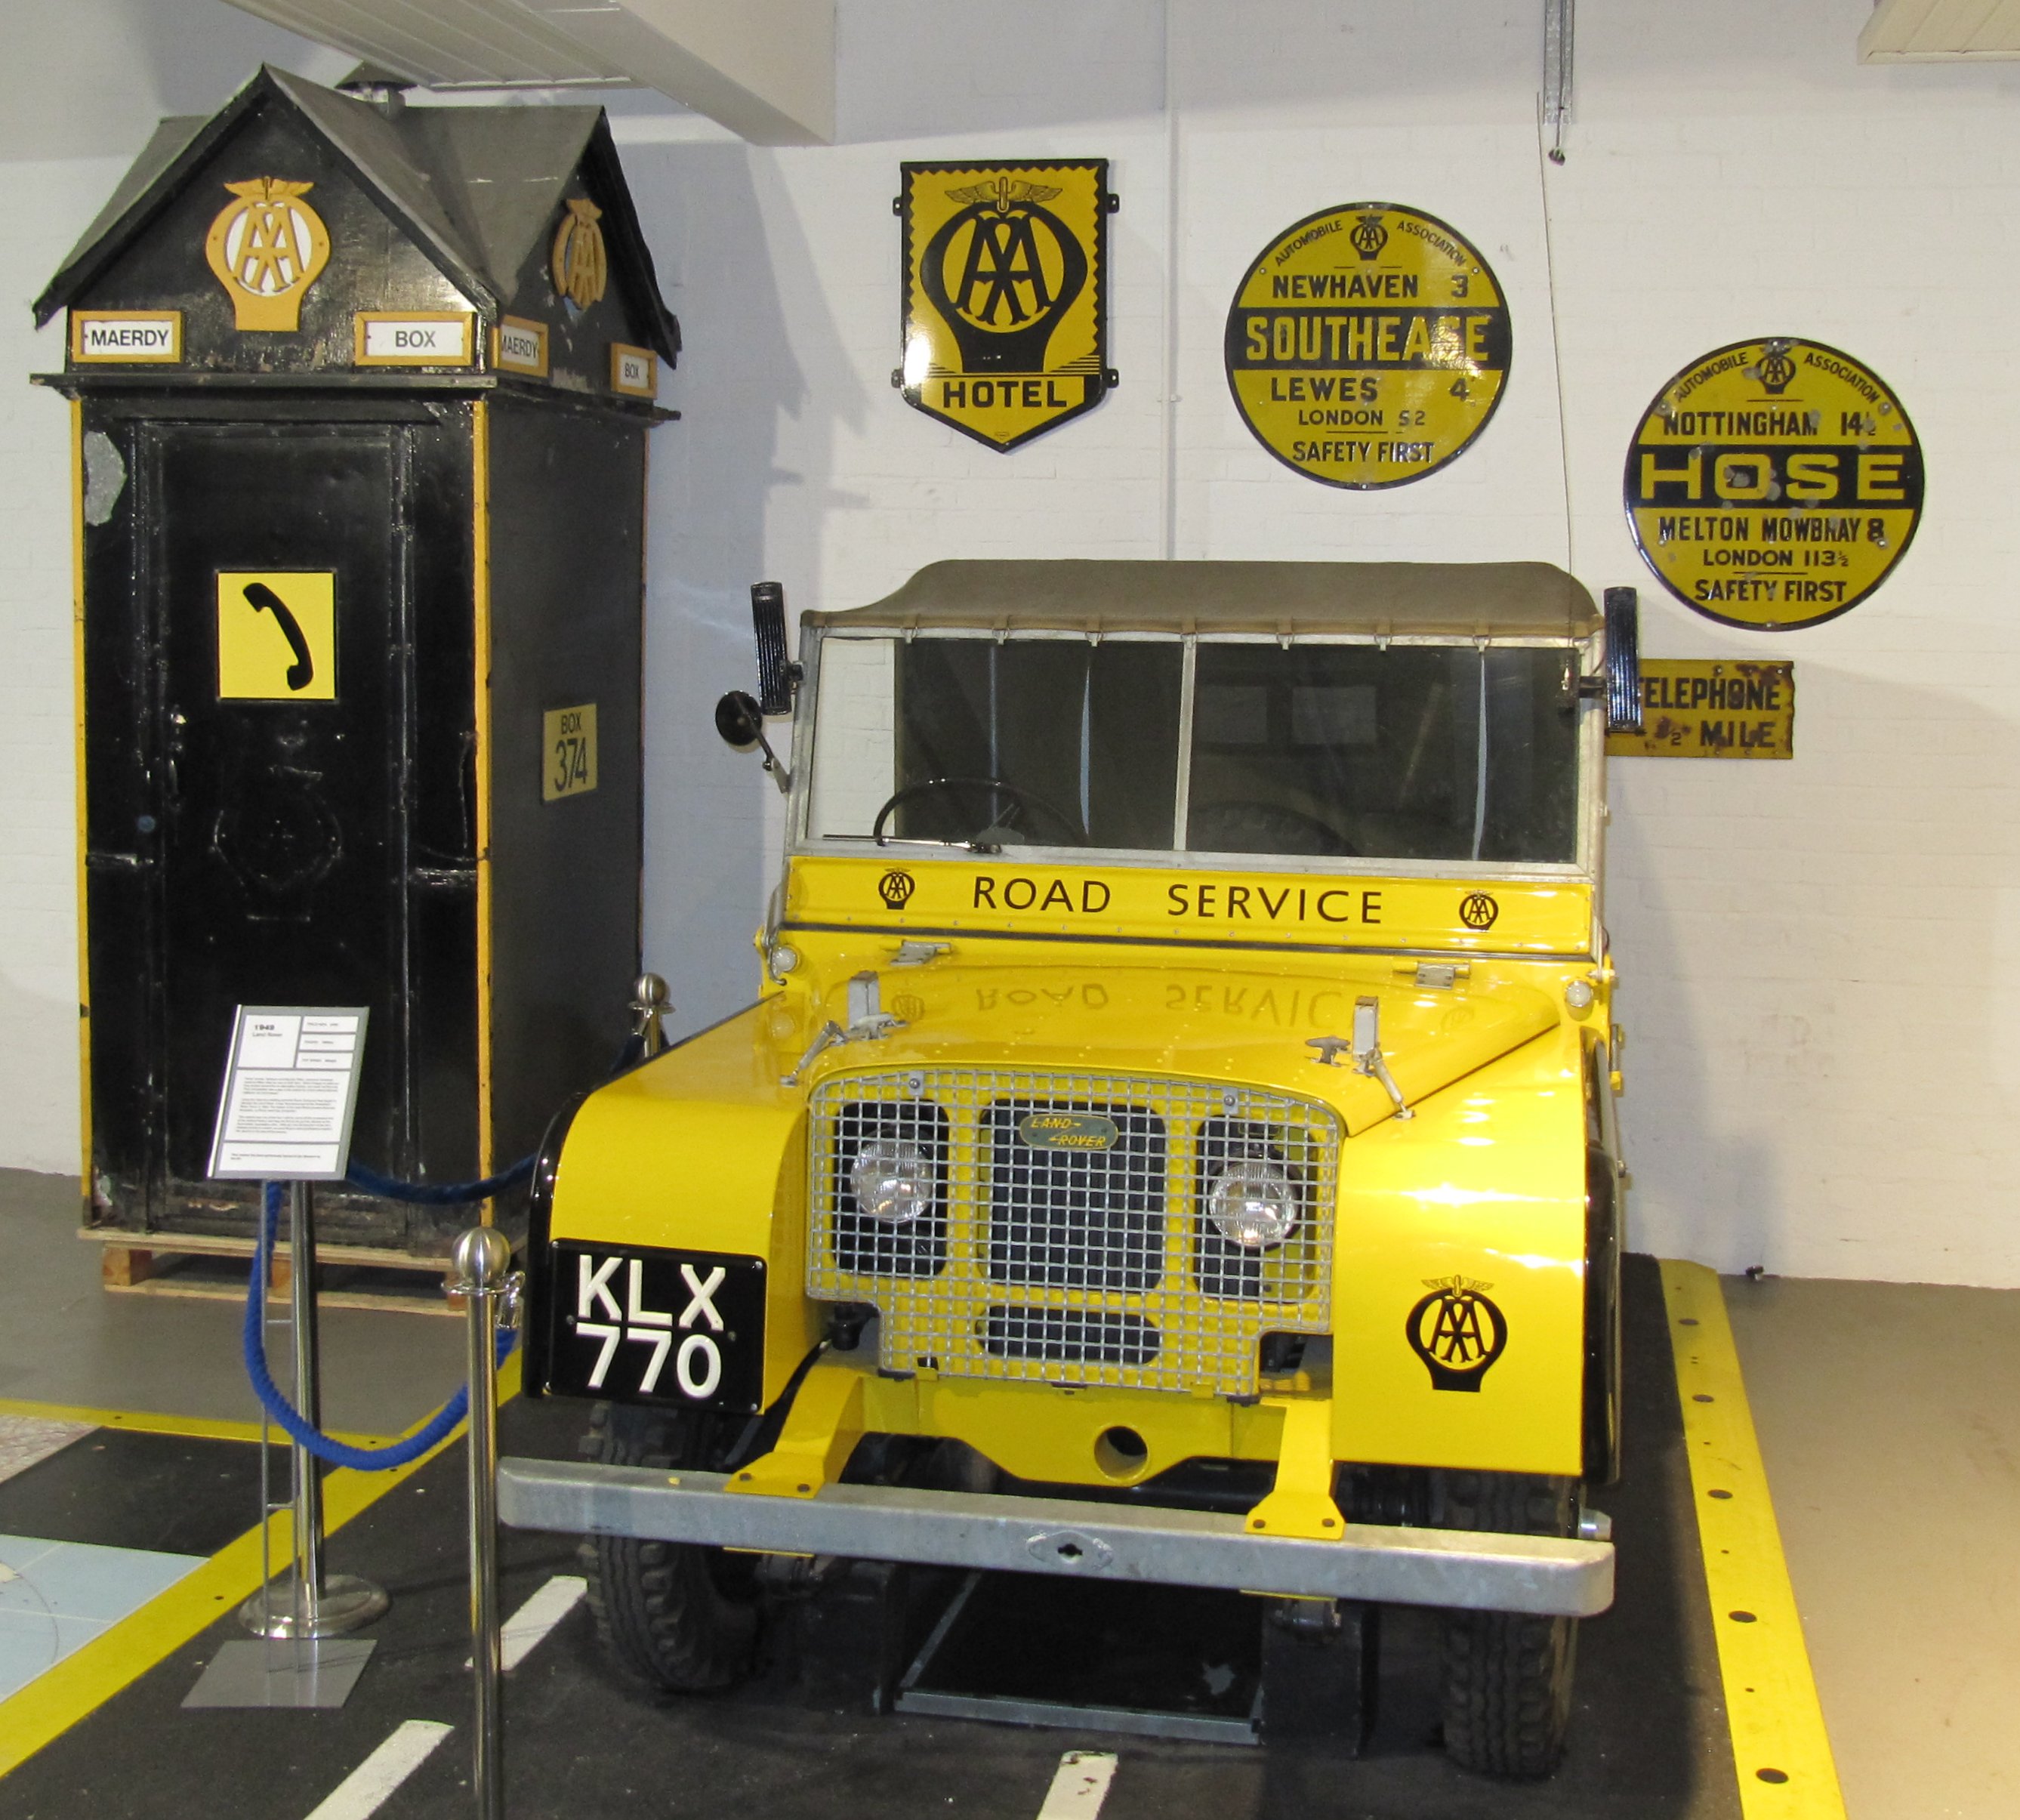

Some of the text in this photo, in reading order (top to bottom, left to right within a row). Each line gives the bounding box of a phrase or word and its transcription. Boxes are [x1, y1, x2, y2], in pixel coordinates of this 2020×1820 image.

[1275, 220, 1466, 267] AUTOMOBILE ASSOCIATION
[1272, 273, 1468, 298] NEWHAVEN 3
[91, 329, 436, 347] MAERDY BOX
[1246, 316, 1489, 361] SOUTHEASE
[625, 362, 640, 378] BOX
[1674, 352, 1880, 403] AUTOMOBILE ASSOCIATION
[943, 381, 1068, 408] HOTEL
[1271, 378, 1470, 403] LEWES 4
[1298, 410, 1383, 426] LONDON
[1663, 412, 1818, 436] NOTTINGHAM
[1292, 441, 1436, 464] SAFETY FIRST
[1641, 453, 1905, 500] HOSE
[1659, 517, 1885, 542] MELTON MOWBRAY 8
[1703, 549, 1793, 566] LONDON
[1695, 580, 1848, 603] SAFETY FIRST
[561, 713, 581, 735] BOX
[1700, 720, 1776, 748] MILE
[554, 737, 587, 791] 374
[973, 876, 1382, 924] ROAD SERVICE
[578, 1254, 726, 1331] KLX
[576, 1322, 721, 1398] 770
